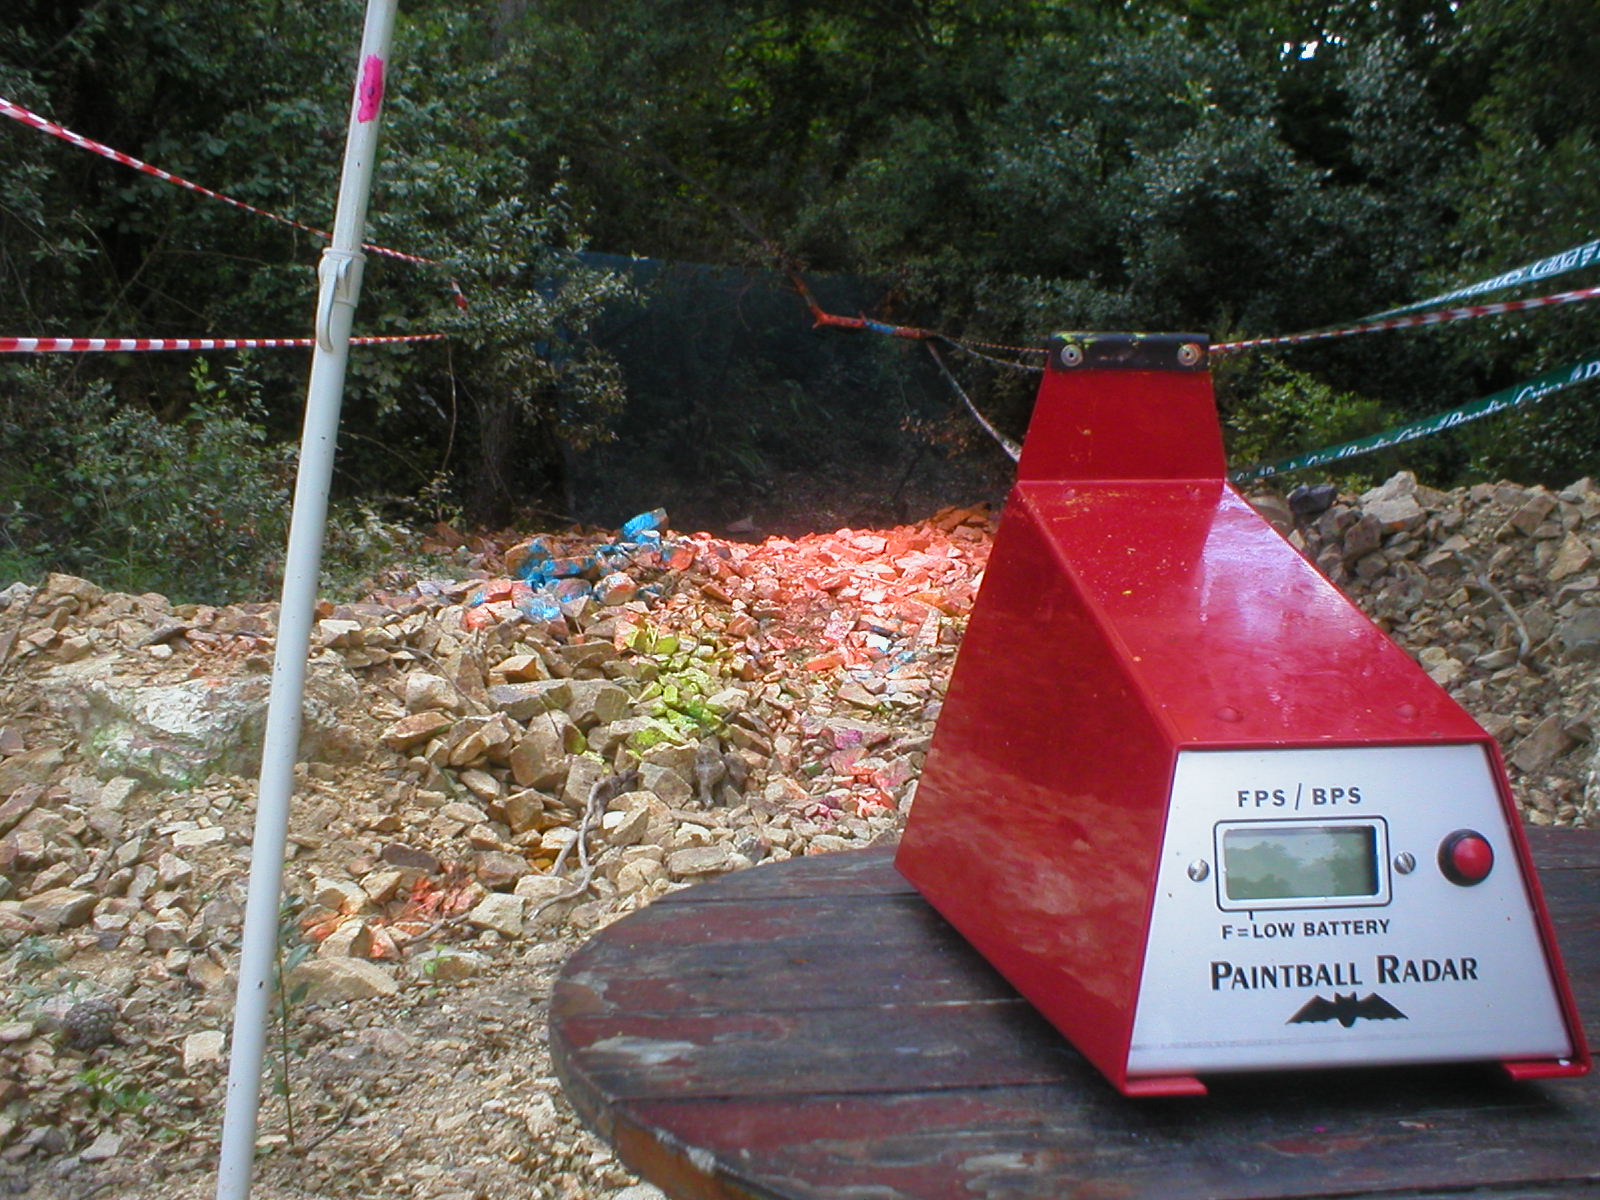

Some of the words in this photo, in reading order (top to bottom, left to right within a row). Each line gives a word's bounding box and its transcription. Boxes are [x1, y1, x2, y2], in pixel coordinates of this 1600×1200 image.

[1303, 918, 1391, 937] BATTERY
[1210, 960, 1363, 991] PAINTBALL
[1376, 954, 1479, 984] RADAR
